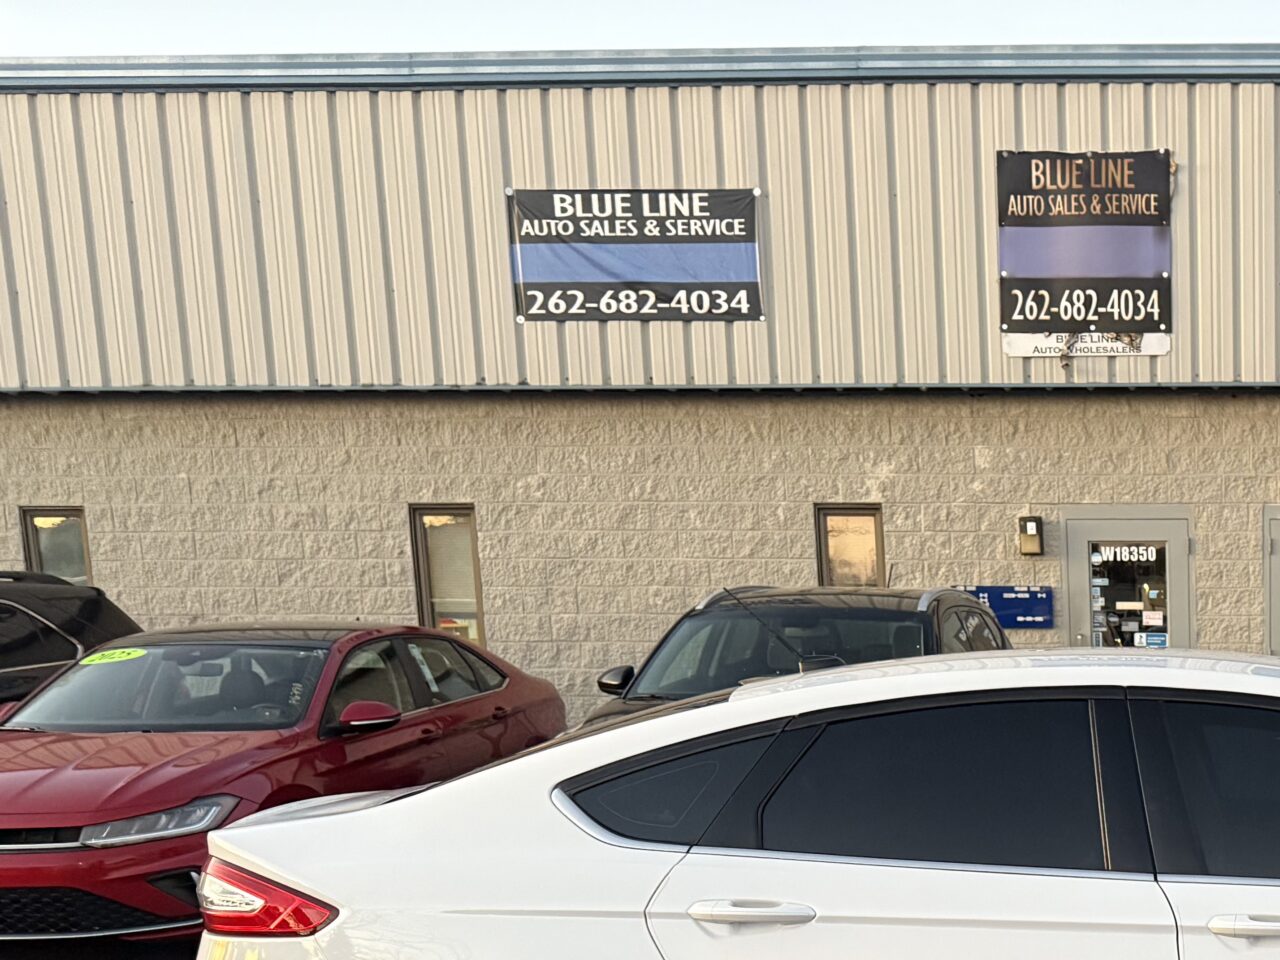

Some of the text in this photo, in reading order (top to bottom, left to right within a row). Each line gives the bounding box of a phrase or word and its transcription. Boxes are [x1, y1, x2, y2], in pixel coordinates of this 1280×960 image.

[1031, 158, 1135, 190] BLUE LINE
[553, 192, 710, 218] BLUE LINE
[1007, 193, 1159, 216] AUTO SALES & SERVICE
[520, 218, 746, 237] AUTO SALES & SERVICE
[526, 289, 750, 315] 262-682-4034
[1011, 288, 1160, 321] 262-682-4034
[1056, 335, 1087, 343] BE
[1101, 546, 1157, 561] W18350
